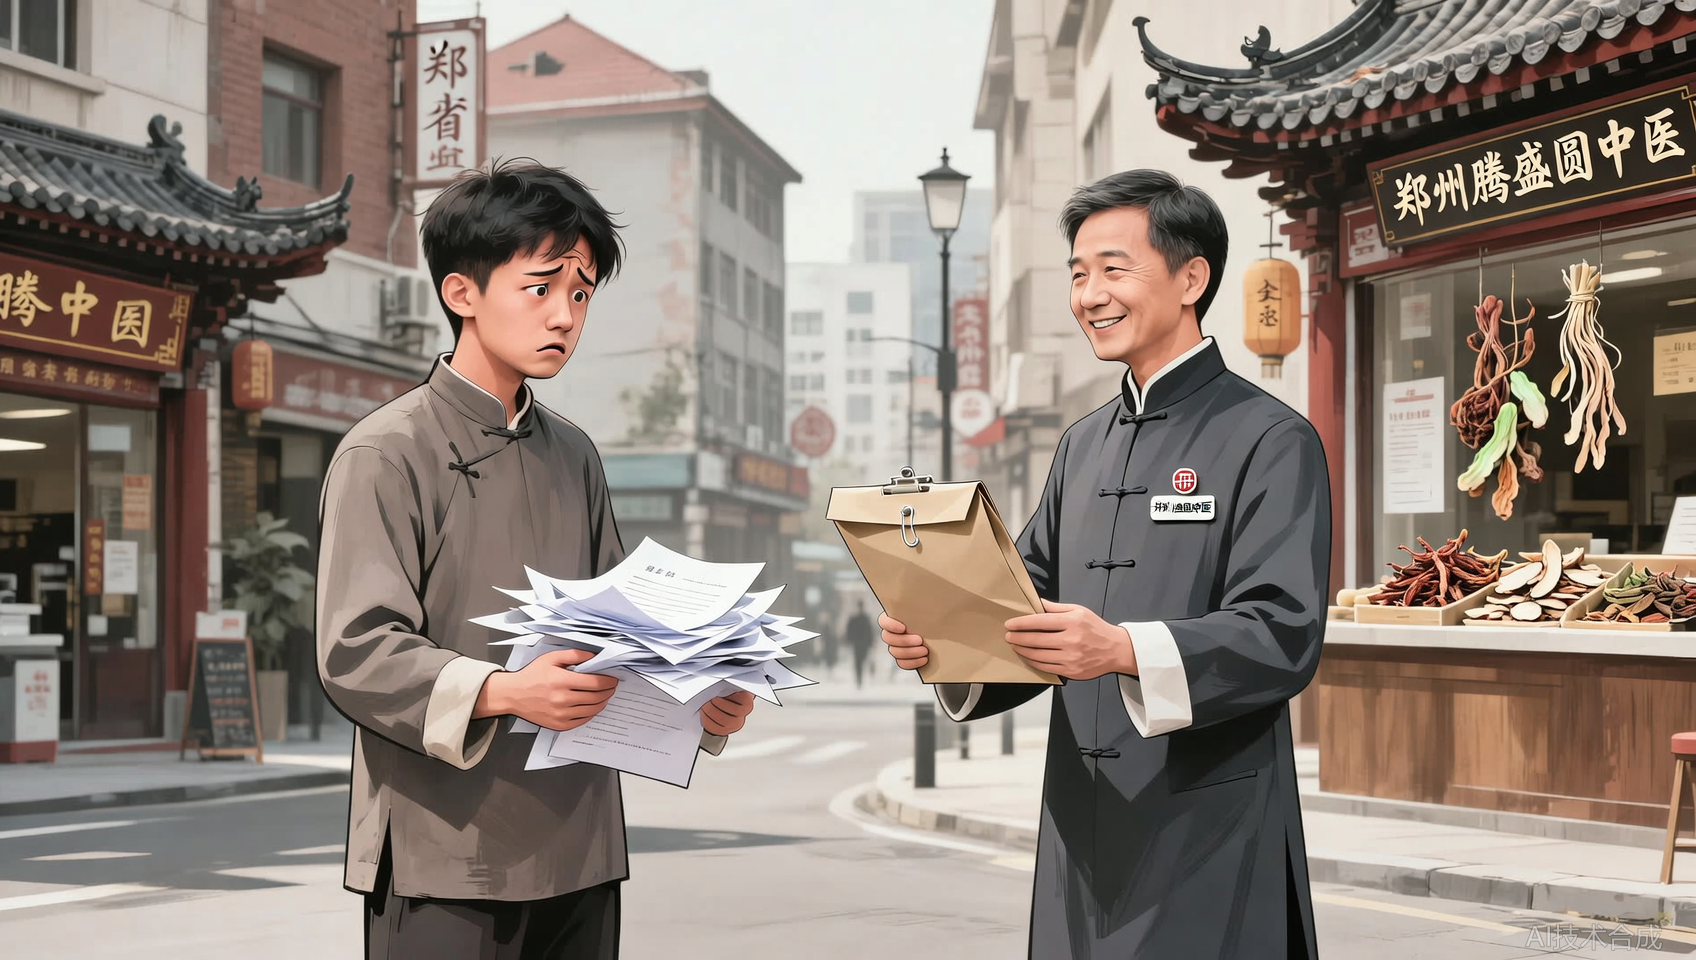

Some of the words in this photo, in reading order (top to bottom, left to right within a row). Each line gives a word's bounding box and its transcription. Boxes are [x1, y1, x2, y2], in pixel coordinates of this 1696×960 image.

[1393, 107, 1686, 227] 郑州腾盛圆中医
